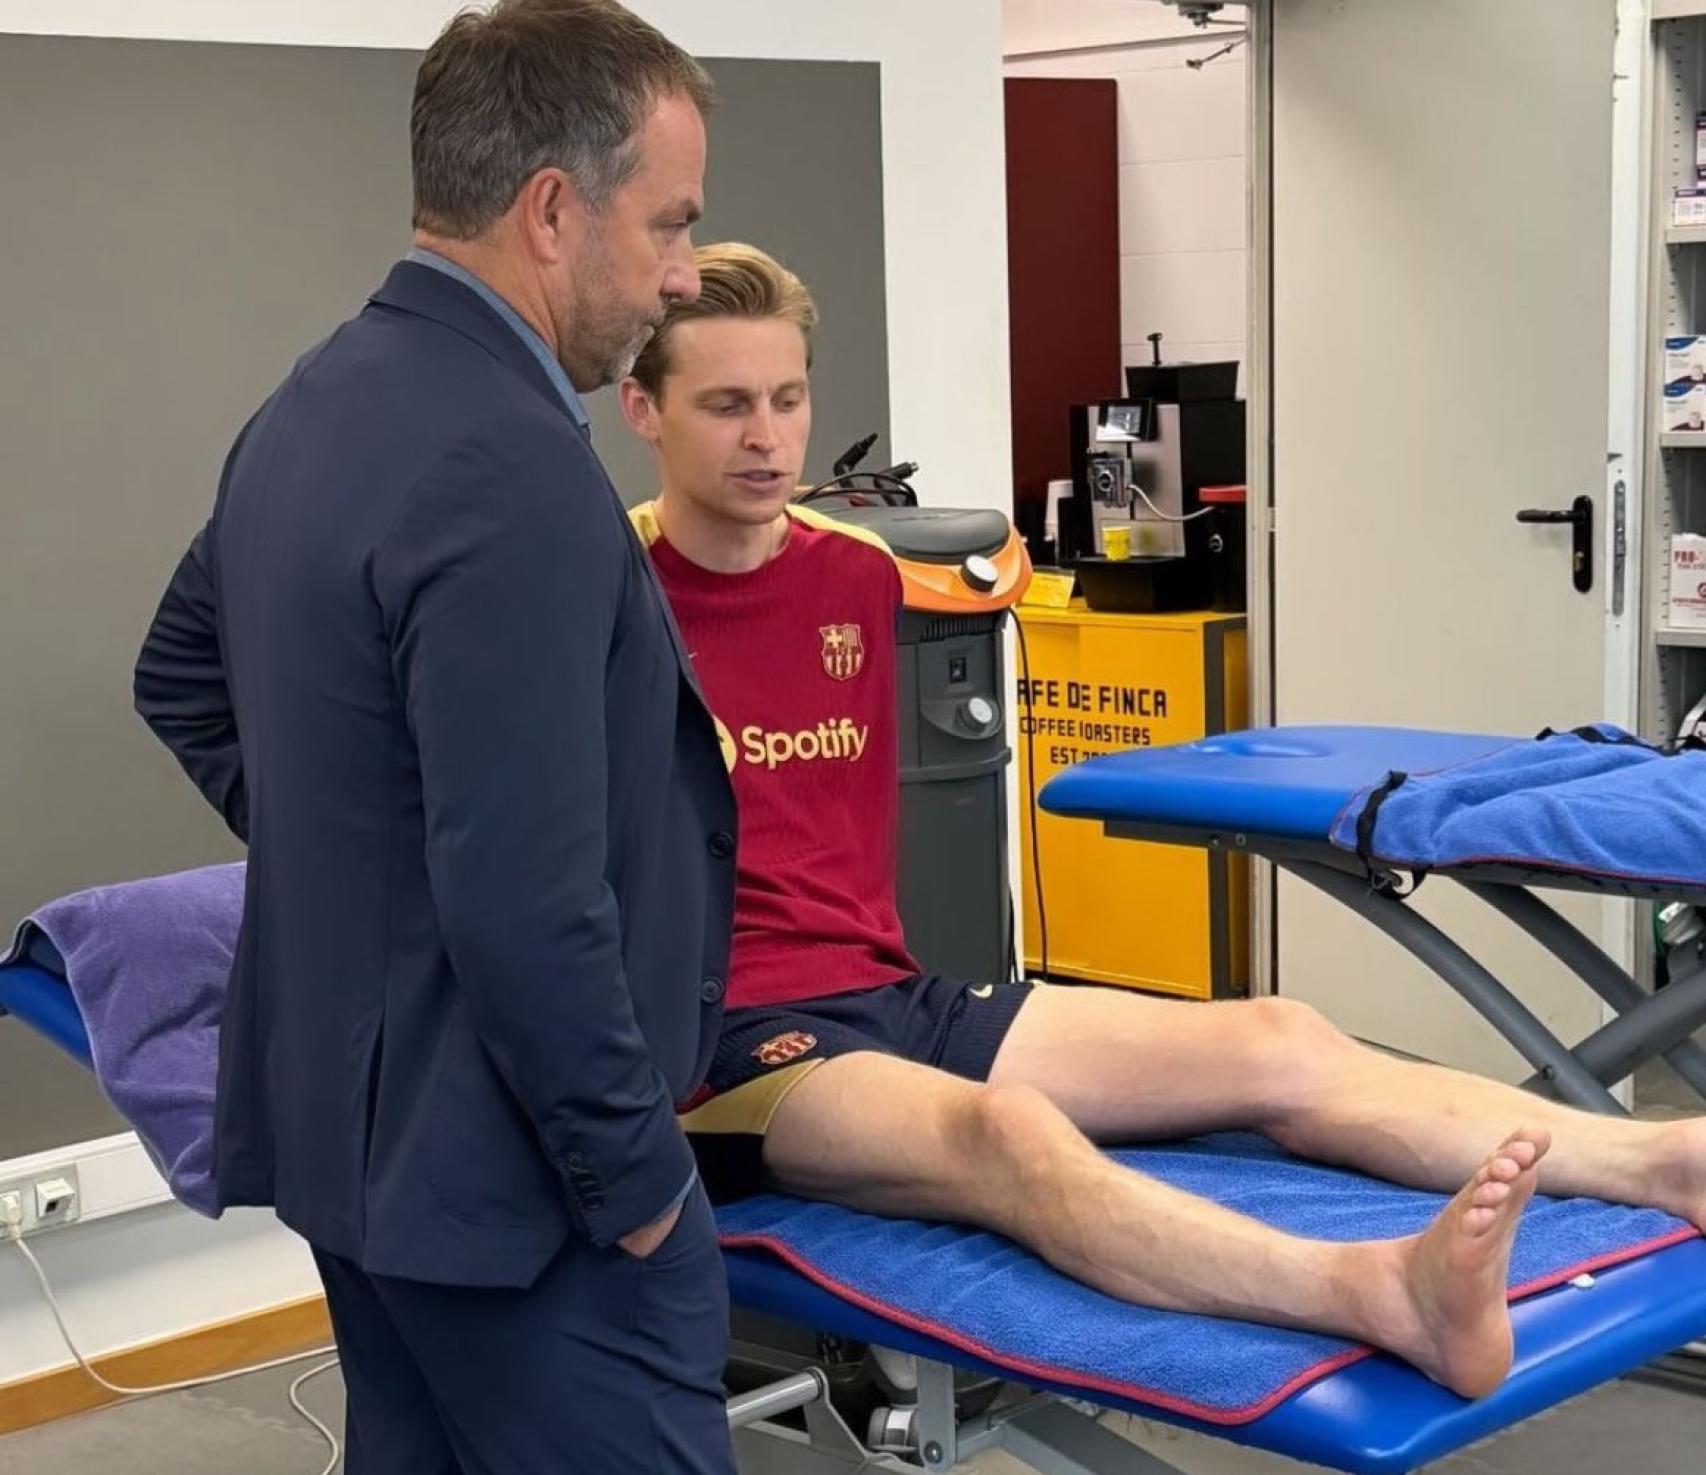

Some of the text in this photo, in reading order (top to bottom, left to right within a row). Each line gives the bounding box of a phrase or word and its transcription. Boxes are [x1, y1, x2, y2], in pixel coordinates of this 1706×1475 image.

[1067, 682, 1091, 712] DE
[1099, 685, 1167, 718] FINCA
[1019, 716, 1076, 737] COFFEE
[741, 717, 868, 770] Spotify
[1050, 746, 1078, 765] EST
